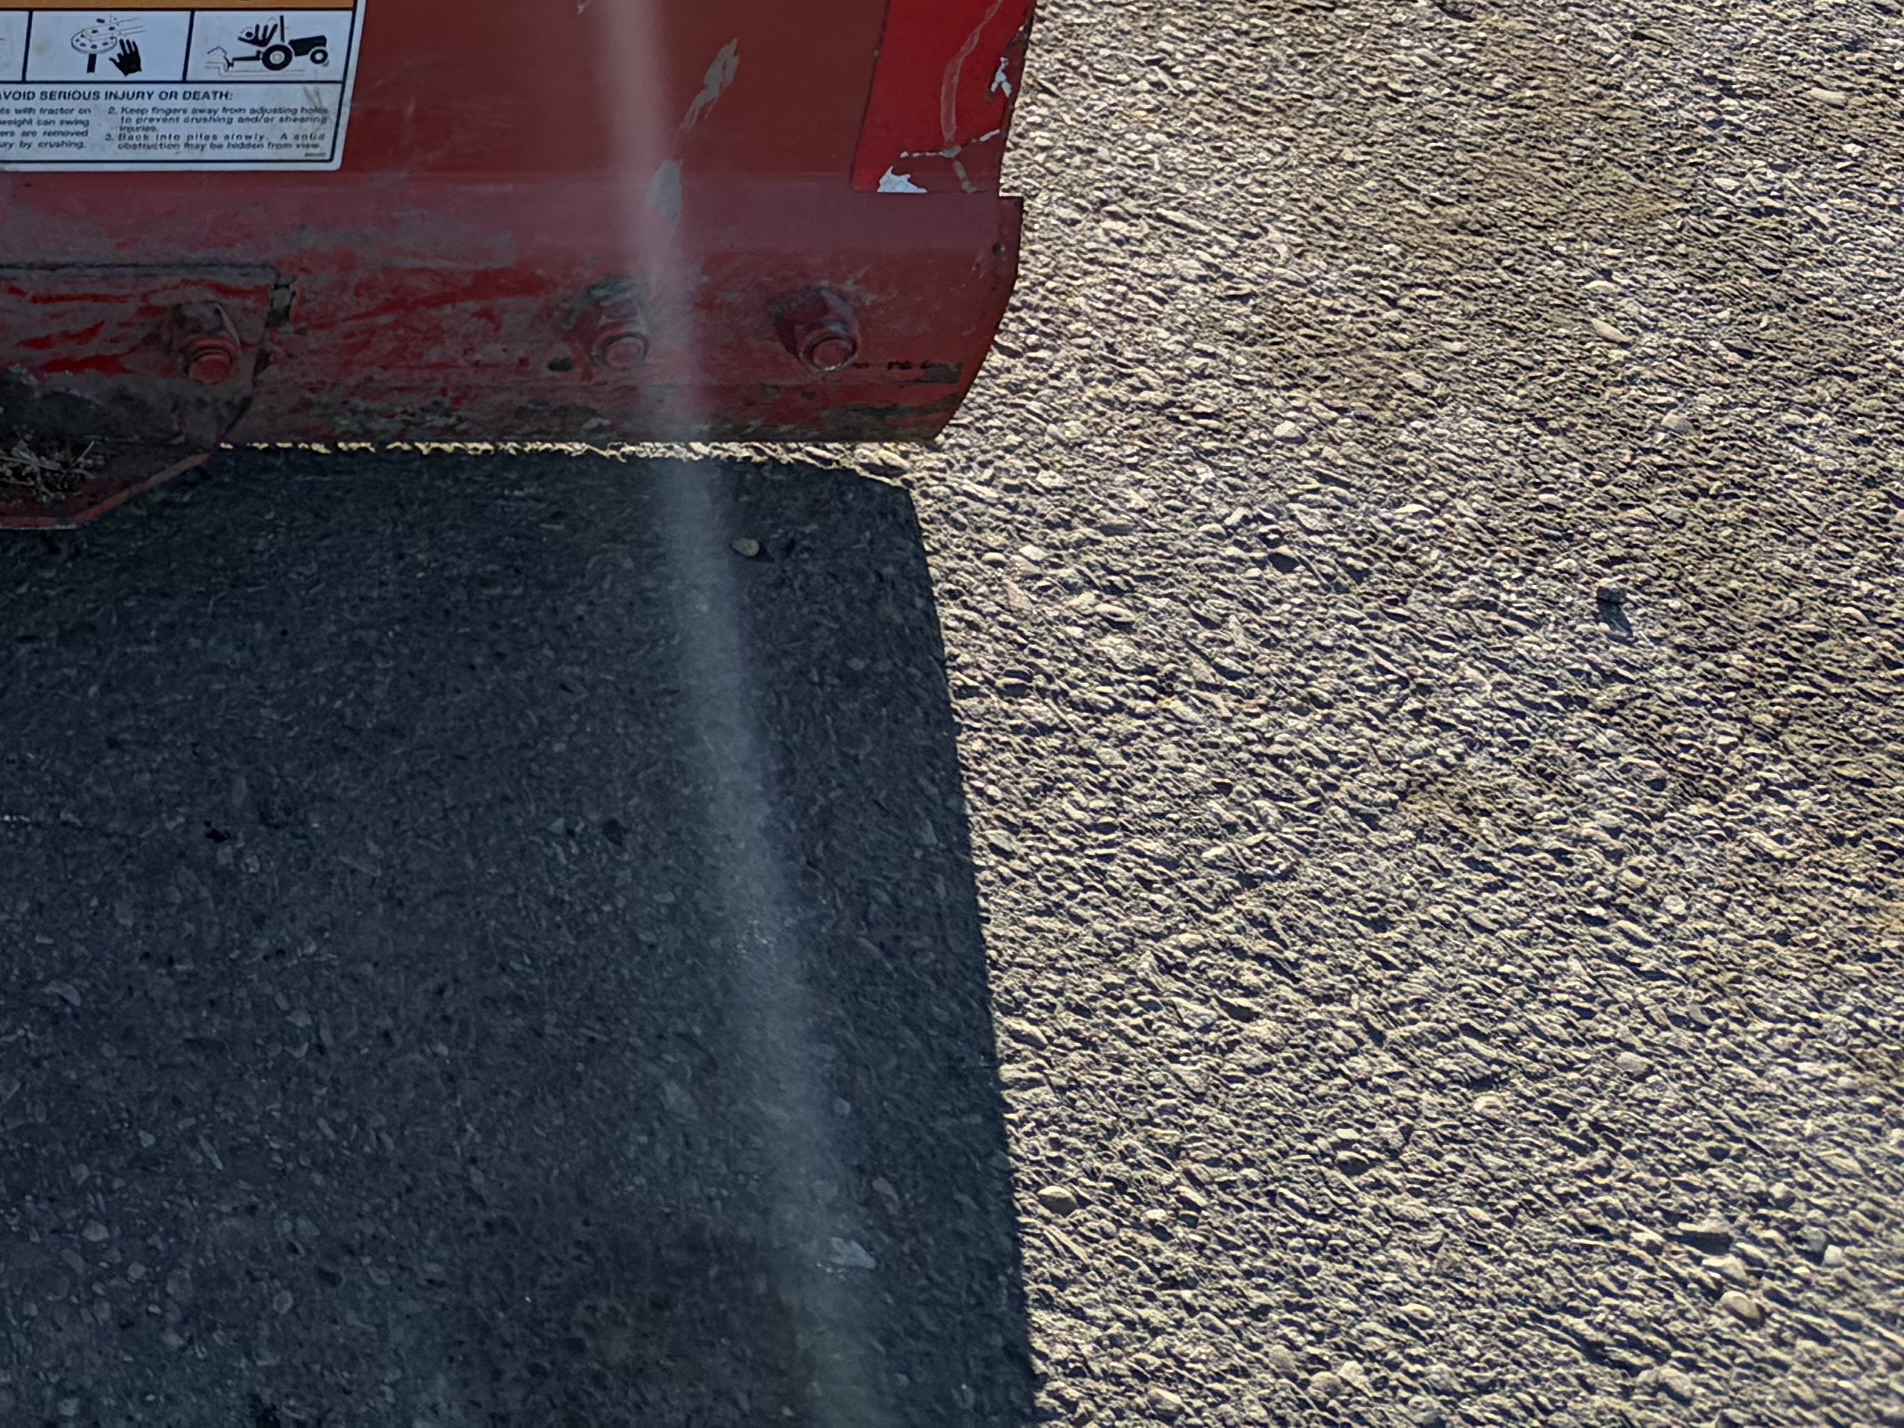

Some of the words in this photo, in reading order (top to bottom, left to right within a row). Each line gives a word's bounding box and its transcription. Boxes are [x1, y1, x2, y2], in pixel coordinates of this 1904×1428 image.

[39, 90, 100, 100] SERIOUS
[104, 91, 153, 100] INJURY
[158, 90, 178, 100] OR
[182, 90, 232, 100] DEATH:
